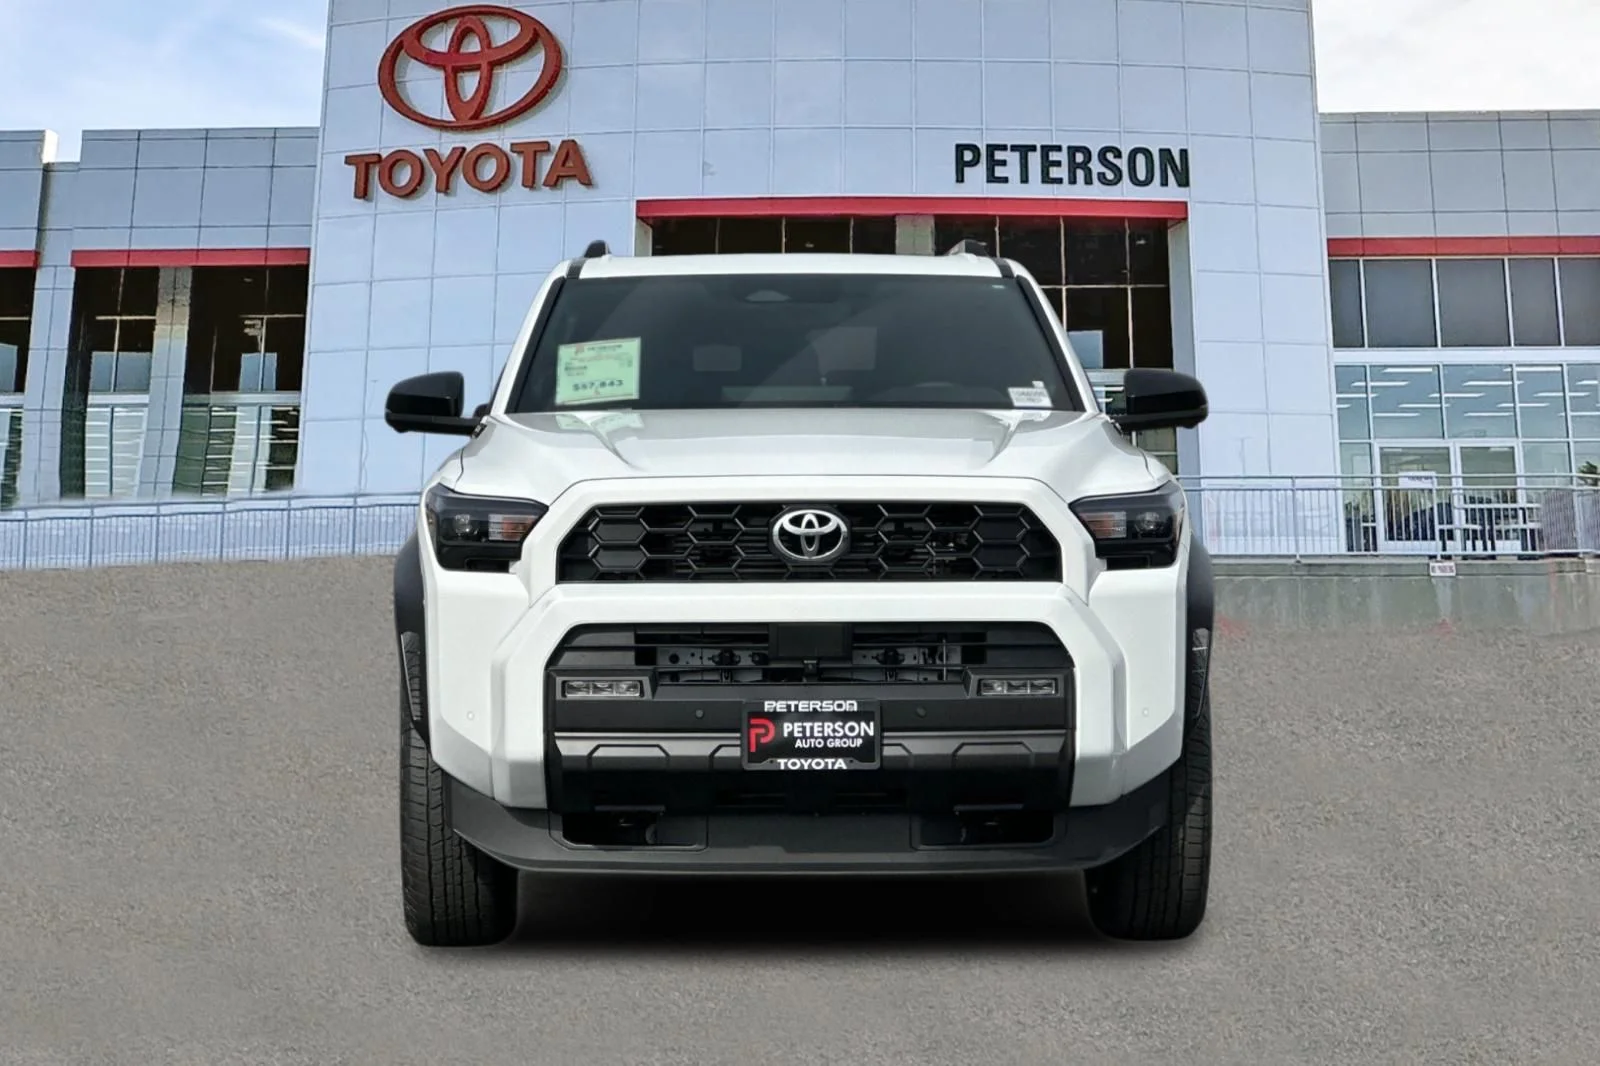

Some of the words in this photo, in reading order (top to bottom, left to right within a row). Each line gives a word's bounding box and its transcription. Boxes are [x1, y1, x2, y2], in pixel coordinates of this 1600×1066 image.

[344, 138, 593, 200] TOYOTA
[954, 143, 1191, 188] PETERSON
[764, 700, 858, 712] PETERSON
[783, 721, 875, 738] PETERSON
[794, 738, 824, 749] AUTO
[826, 738, 864, 748] GROUP
[777, 758, 848, 770] TOYOTA
